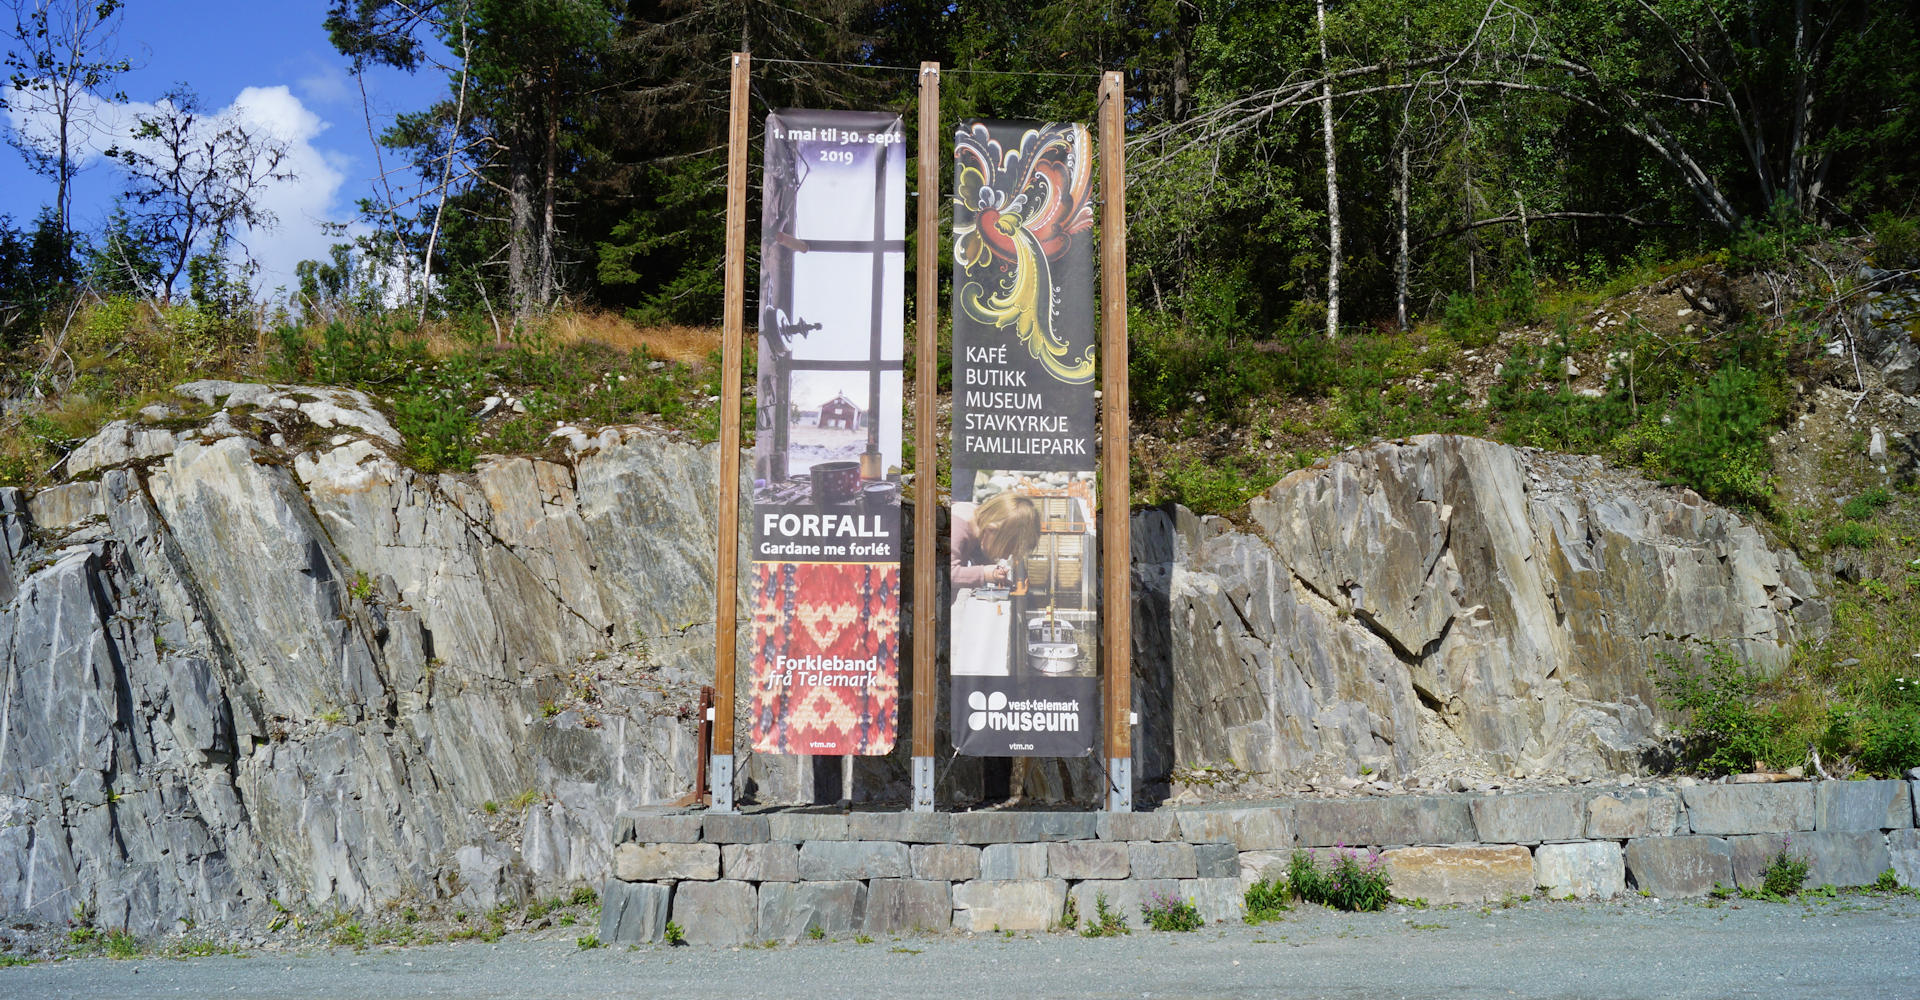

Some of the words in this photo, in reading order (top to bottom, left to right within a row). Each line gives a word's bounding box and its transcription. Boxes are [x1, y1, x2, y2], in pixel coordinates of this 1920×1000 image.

[773, 129, 784, 139] 1.
[788, 128, 816, 141] mai
[821, 128, 836, 142] til
[840, 131, 863, 145] 30.
[867, 131, 901, 147] sept
[820, 150, 854, 165] 2019
[966, 344, 1007, 364] KAFÉ
[966, 369, 1027, 387] BUTIKK
[965, 391, 1042, 410] MUSEUM
[965, 413, 1069, 432] STAVKYRKJE
[965, 436, 1086, 455] FAMLILIEPARK
[763, 514, 889, 537] FORFALL
[760, 542, 819, 555] Gardane
[824, 544, 846, 555] me
[849, 542, 890, 556] forlét
[776, 655, 877, 671] Forkleband
[767, 670, 792, 690] frå
[798, 671, 877, 687] Telemark
[1008, 699, 1079, 712] vest-telemark
[988, 711, 1079, 732] museum
[809, 741, 836, 749] vtm.no
[1008, 743, 1034, 751] vtm.no
